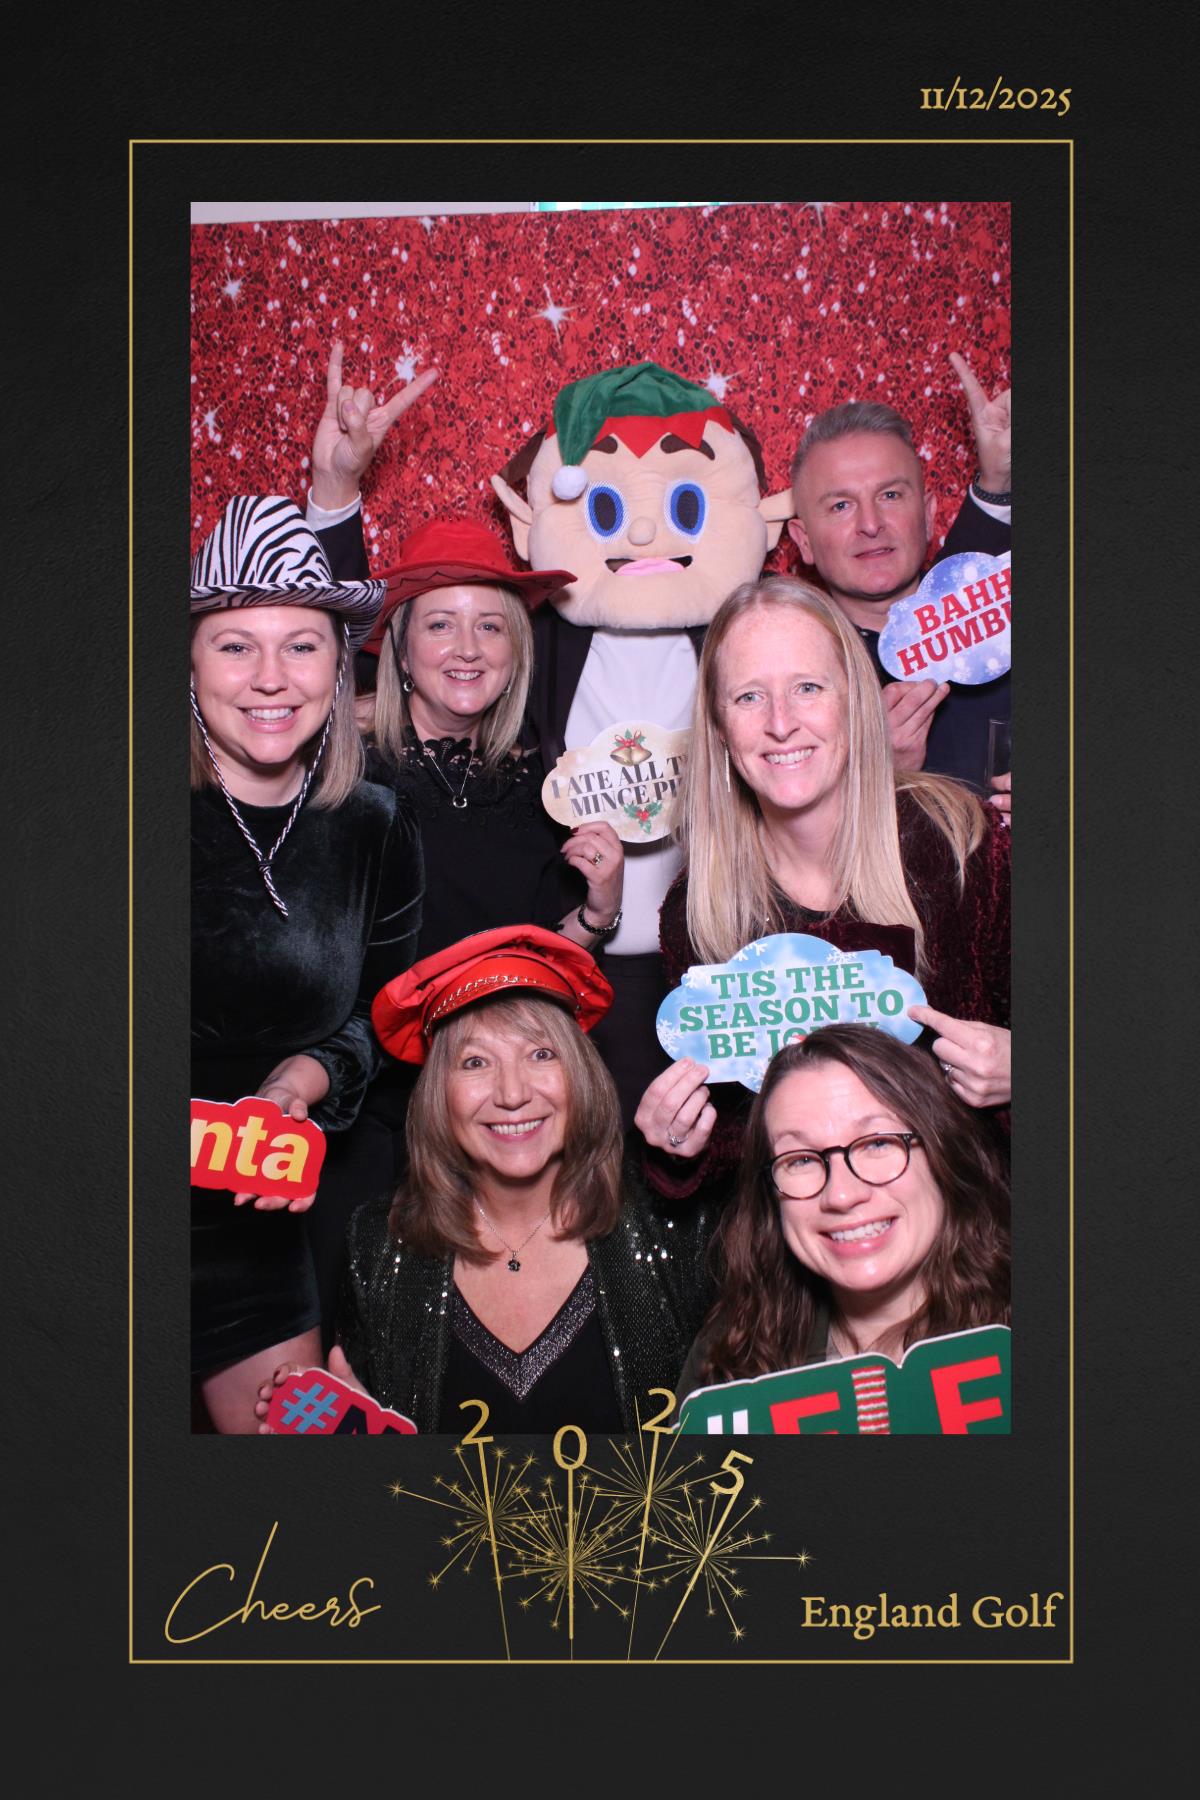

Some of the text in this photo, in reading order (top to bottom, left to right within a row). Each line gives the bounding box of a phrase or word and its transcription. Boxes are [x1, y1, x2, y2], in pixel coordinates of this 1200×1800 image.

[913, 567, 1011, 635] BAHH
[551, 779, 561, 799] I
[568, 770, 612, 796] ATE
[619, 761, 664, 787] ALL
[571, 777, 682, 817] MINCE PI
[711, 963, 865, 999] TIS THE
[679, 989, 904, 1032] SEASON TO
[707, 1031, 756, 1059] BE
